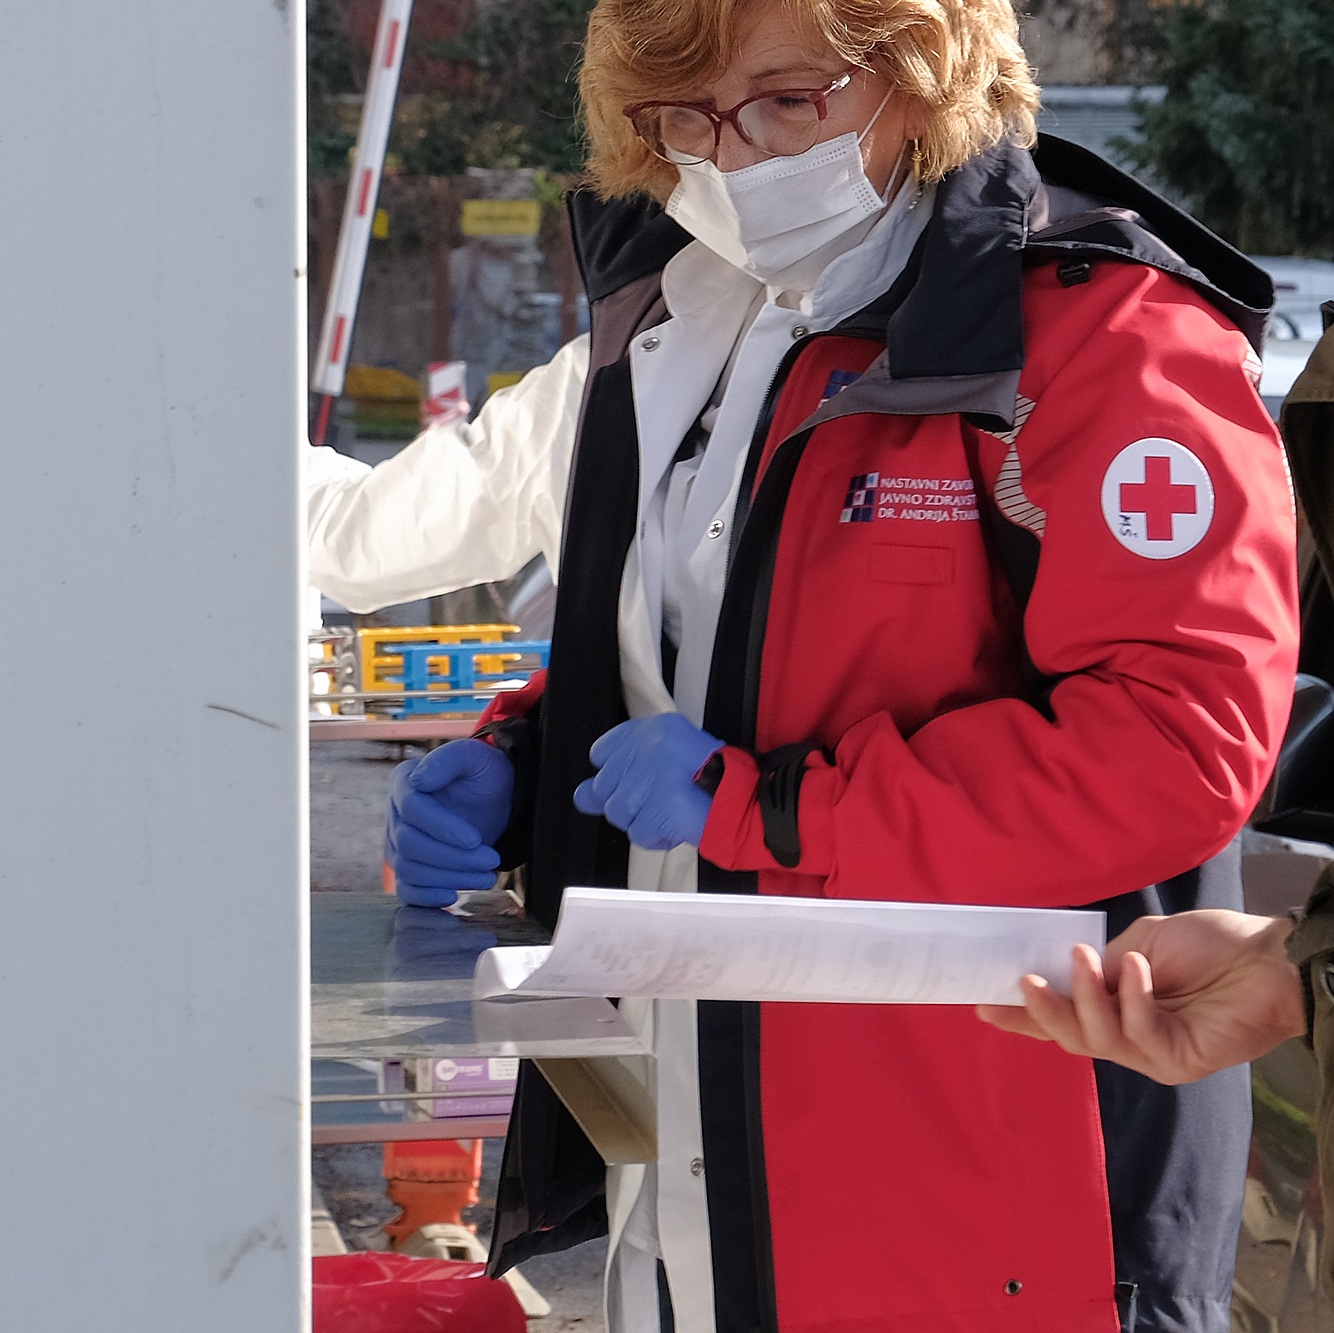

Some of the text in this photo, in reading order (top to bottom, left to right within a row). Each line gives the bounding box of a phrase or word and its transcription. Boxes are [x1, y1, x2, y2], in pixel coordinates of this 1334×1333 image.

[880, 477, 940, 491] NASTAVNI
[878, 492, 924, 506] JAVNO
[877, 507, 899, 519] DR.
[899, 508, 951, 523] ANDRIJA
